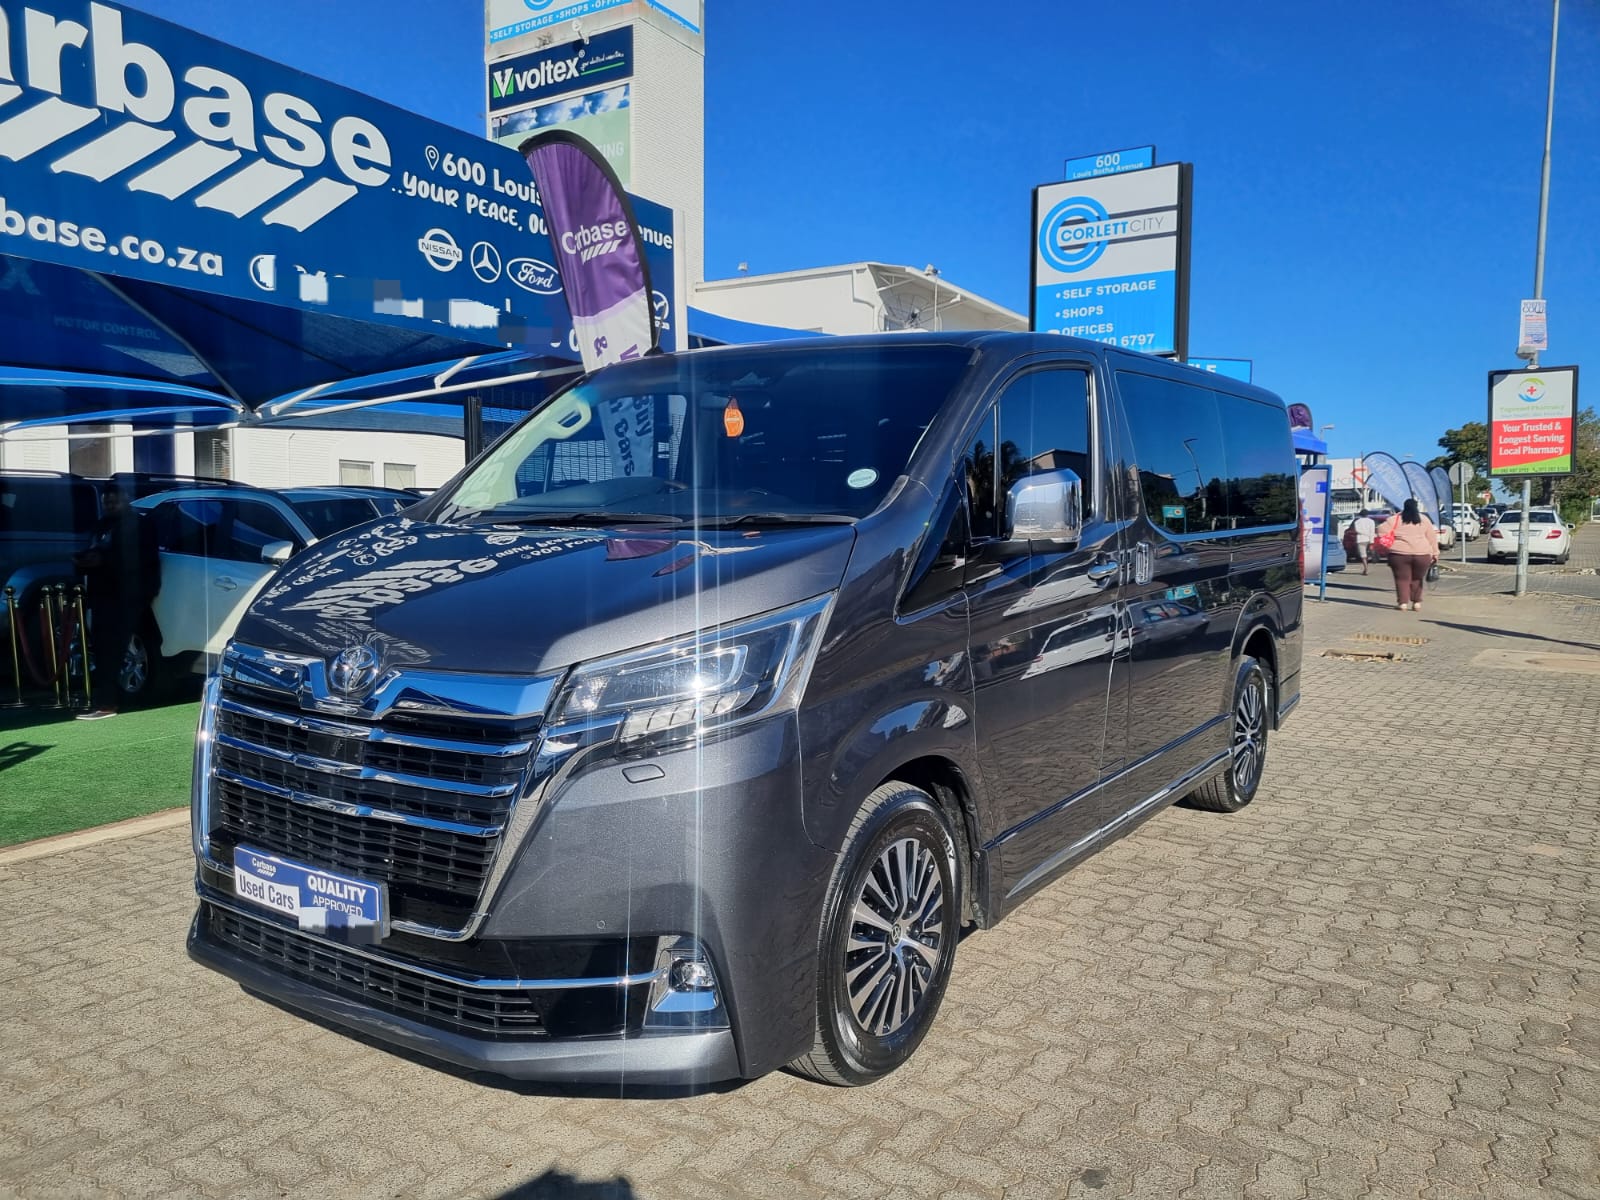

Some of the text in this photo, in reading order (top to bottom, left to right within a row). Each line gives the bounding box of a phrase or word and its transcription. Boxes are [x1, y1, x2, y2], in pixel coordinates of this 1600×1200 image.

[559, 3, 589, 19] SHOPS
[493, 14, 554, 39] SELF STORAGE
[515, 57, 579, 91] voltex
[0, 1, 391, 187] rbase
[442, 152, 487, 187] 600
[1096, 153, 1120, 168] 600
[421, 241, 461, 258] NISSAN
[517, 262, 554, 289] Ford
[1063, 279, 1157, 299] SELF STORAGE
[1062, 305, 1104, 319] SHOPS
[102, 321, 161, 340] CONTROL
[1062, 322, 1114, 337] OFFICES
[1121, 333, 1155, 346] 6797
[1502, 421, 1562, 433] Your Trusted &
[1499, 433, 1565, 446] Longest Serving
[1499, 445, 1565, 456] Local Pharmacy
[252, 857, 277, 873] Carbase
[239, 874, 295, 910] Used Cars
[307, 874, 367, 904] QUALITY
[312, 894, 363, 918] APPROVED
